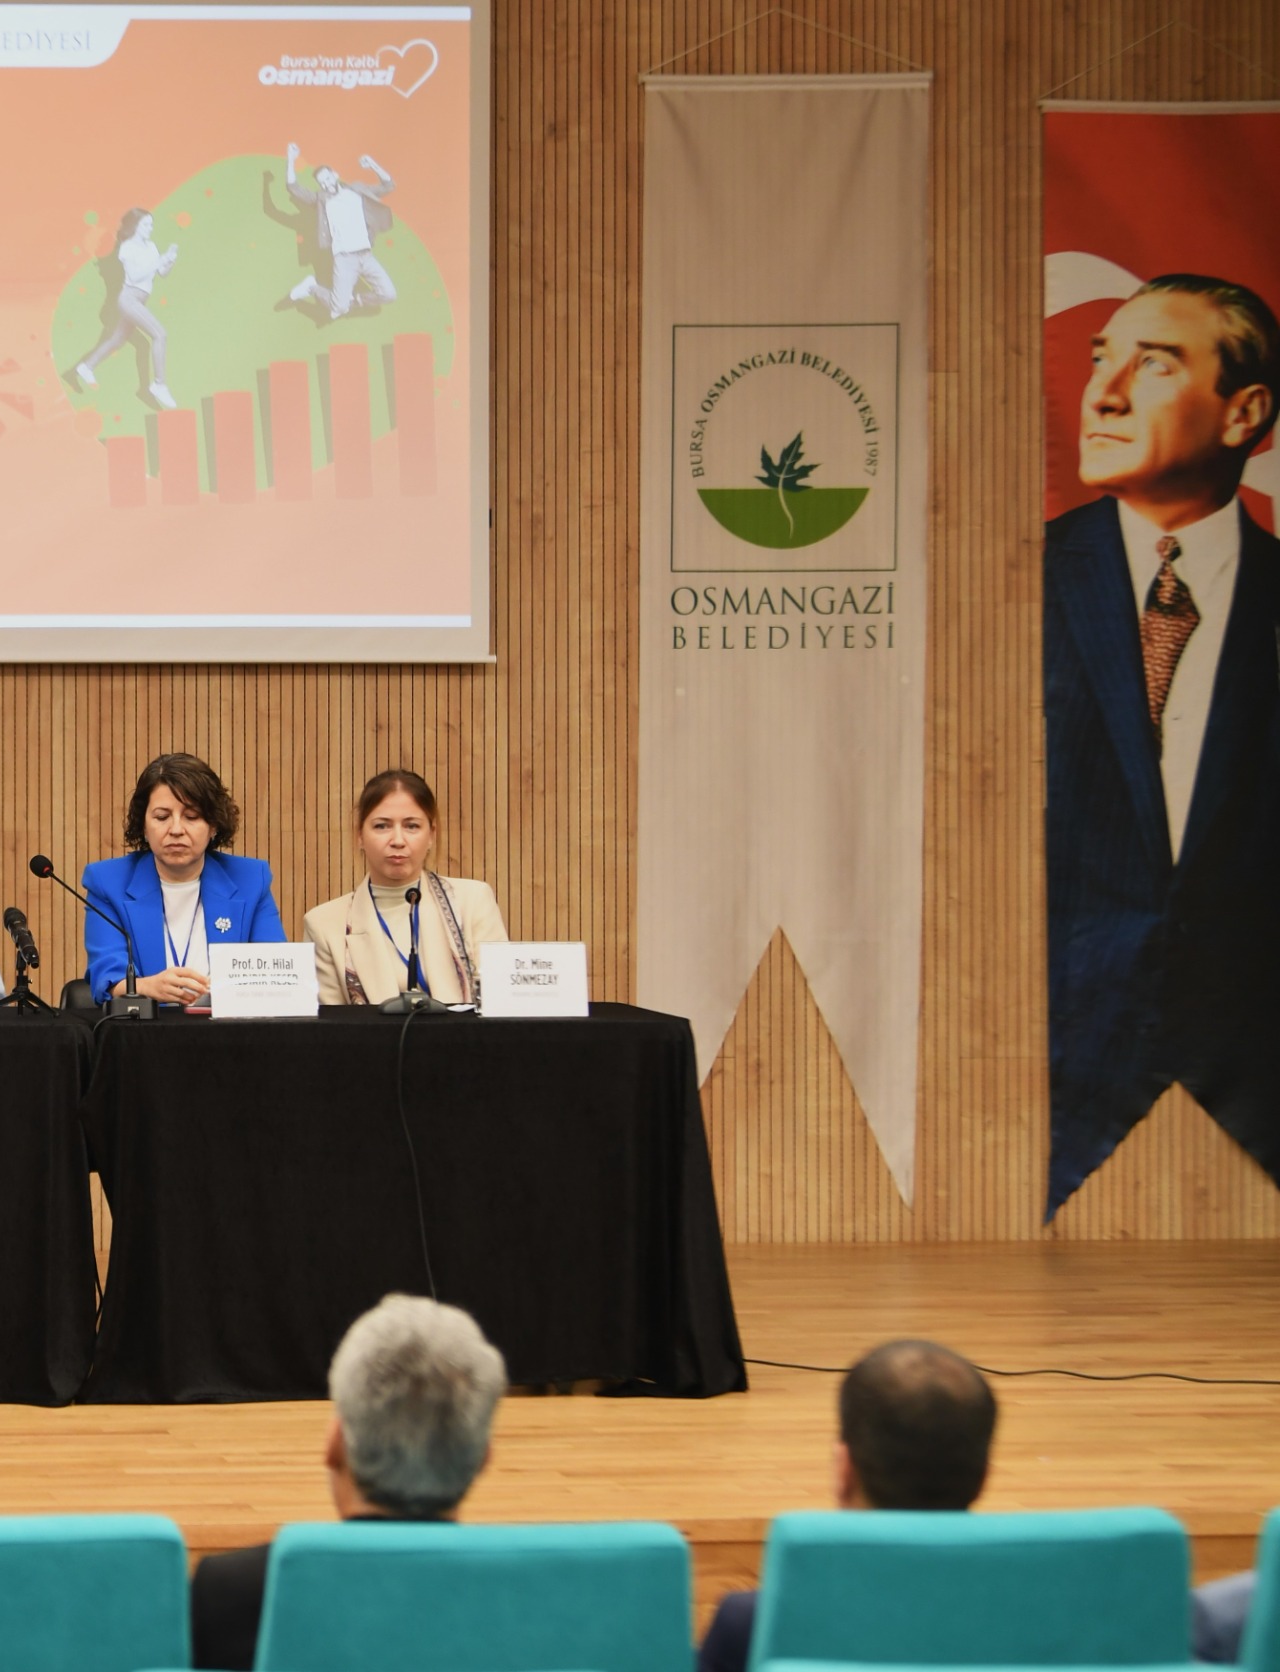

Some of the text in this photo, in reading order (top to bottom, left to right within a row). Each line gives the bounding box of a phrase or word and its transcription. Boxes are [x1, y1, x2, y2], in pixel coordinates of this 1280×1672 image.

[346, 54, 380, 68] Kalbi
[258, 64, 396, 89] Osmangazi
[690, 347, 880, 478] BURSA OSMANGAZİ BELEDİYESİ 1987
[671, 581, 895, 616] OSMANGAZİ
[672, 621, 895, 651] BELEDİYESİ
[232, 958, 294, 970] Prof. Dr. Hilal
[515, 958, 554, 970] Dr. Mine
